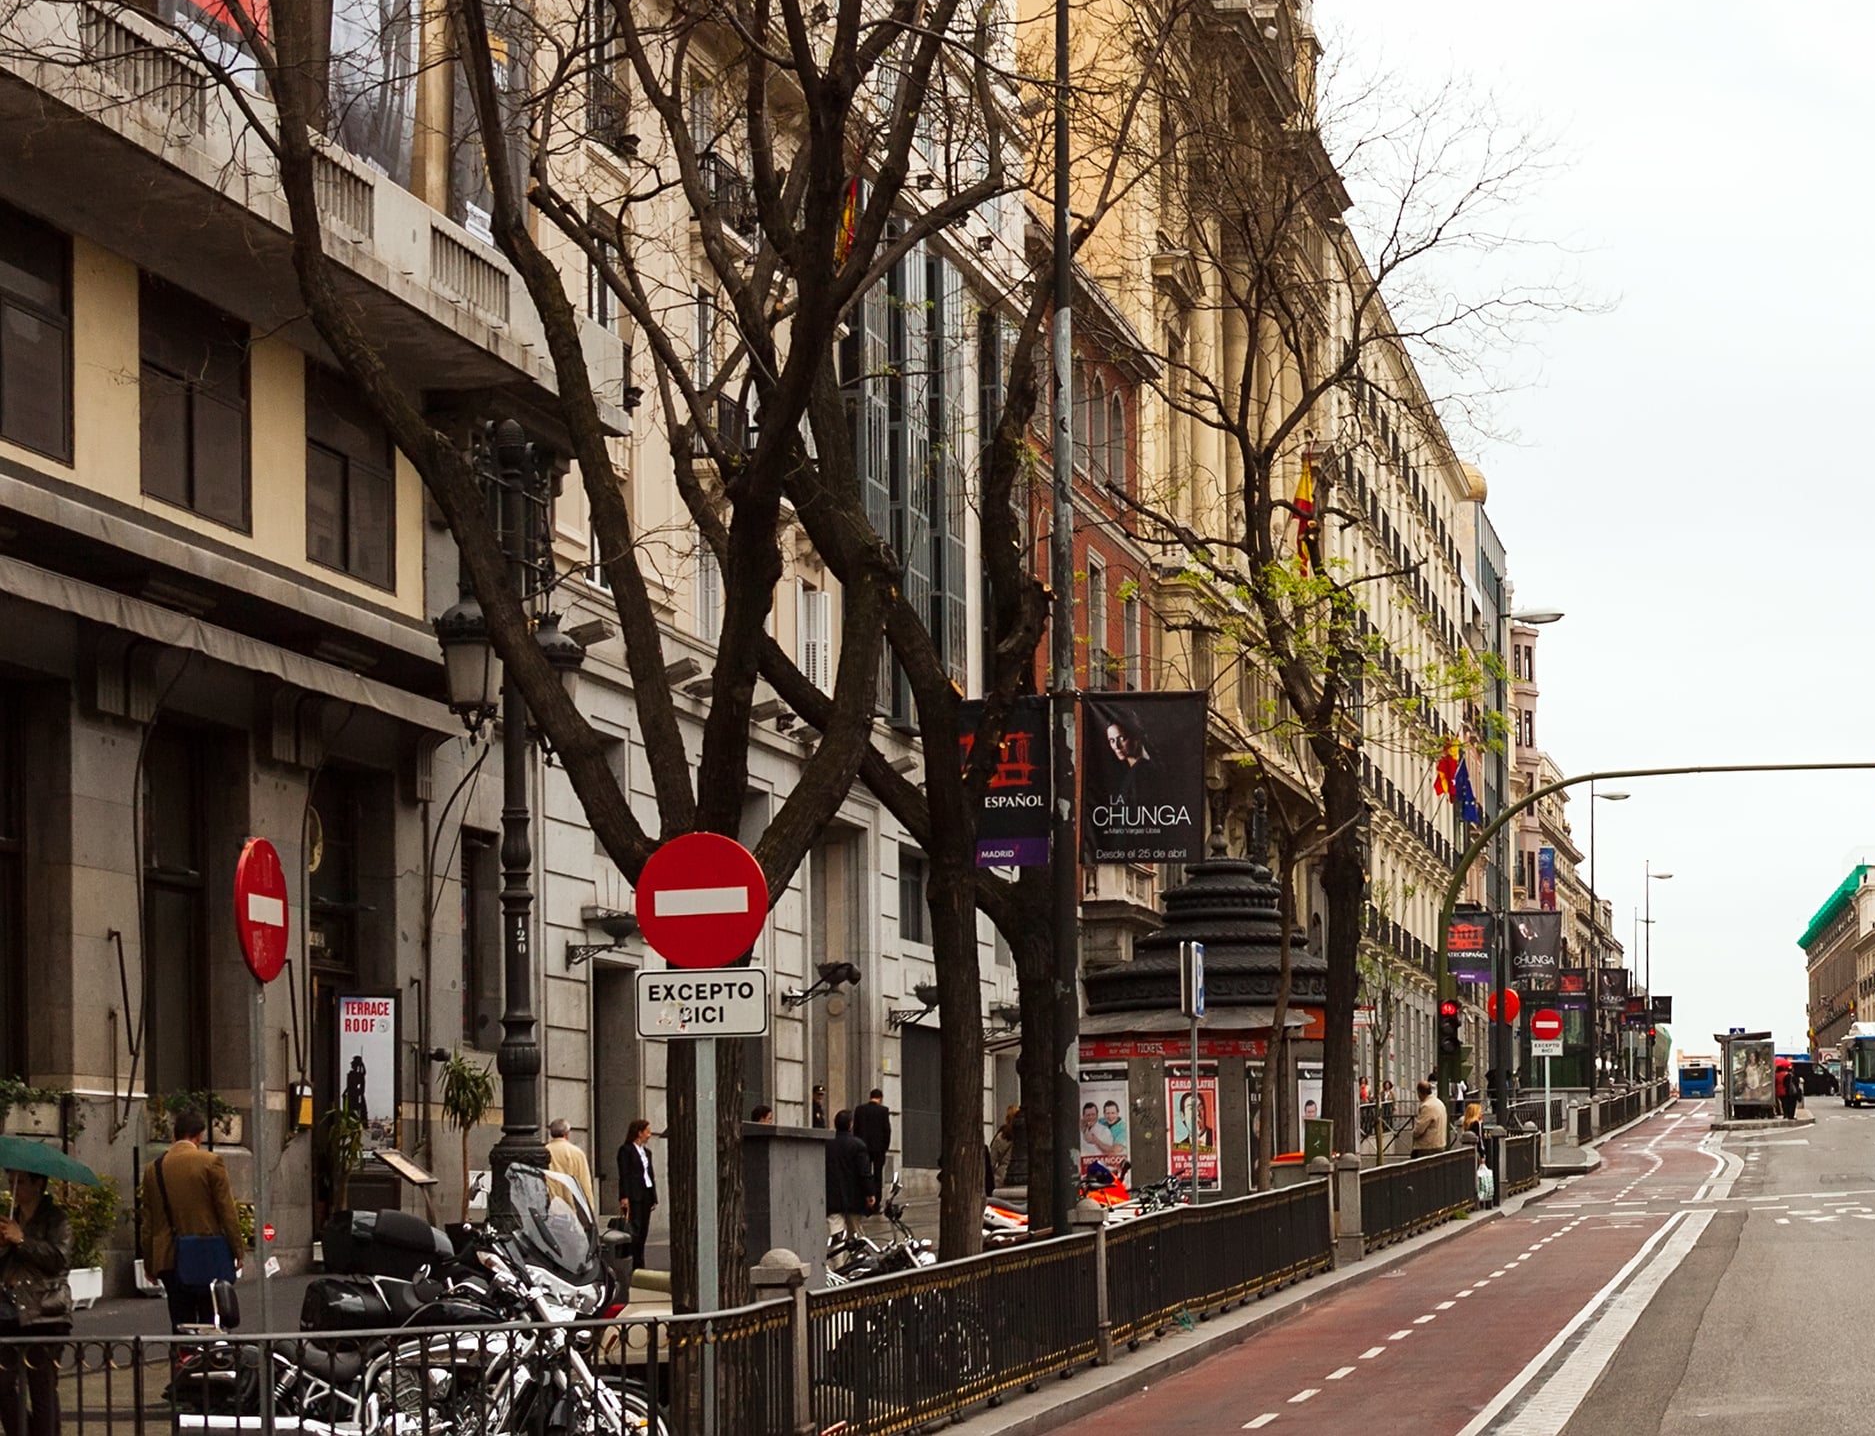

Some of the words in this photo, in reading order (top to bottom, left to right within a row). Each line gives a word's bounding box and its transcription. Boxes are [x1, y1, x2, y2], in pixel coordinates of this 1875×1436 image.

[984, 793, 1044, 809] ESPAÑOL
[1109, 794, 1125, 805] LA
[1092, 805, 1192, 826] CHUNGA
[1125, 828, 1144, 836] Vargas
[981, 850, 1014, 859] MADRID
[1096, 849, 1126, 860] Desde
[1127, 848, 1136, 858] el
[1138, 848, 1151, 858] 25
[1153, 848, 1166, 858] de
[1168, 847, 1187, 858] abril
[517, 916, 526, 954] 120
[1447, 951, 1489, 960] ATROESPAÑOL
[1513, 954, 1555, 966] CHUNGA
[648, 982, 754, 1001] EXCEPTO
[345, 1001, 390, 1016] TERRACE
[680, 1006, 724, 1023] BICI
[345, 1018, 375, 1033] ROOF
[1136, 1042, 1163, 1053] TICKETS
[1170, 1080, 1193, 1090] CARLO
[1172, 1154, 1187, 1163] YES,
[1198, 1154, 1217, 1162] SPAIN
[1175, 1161, 1181, 1169] IS
